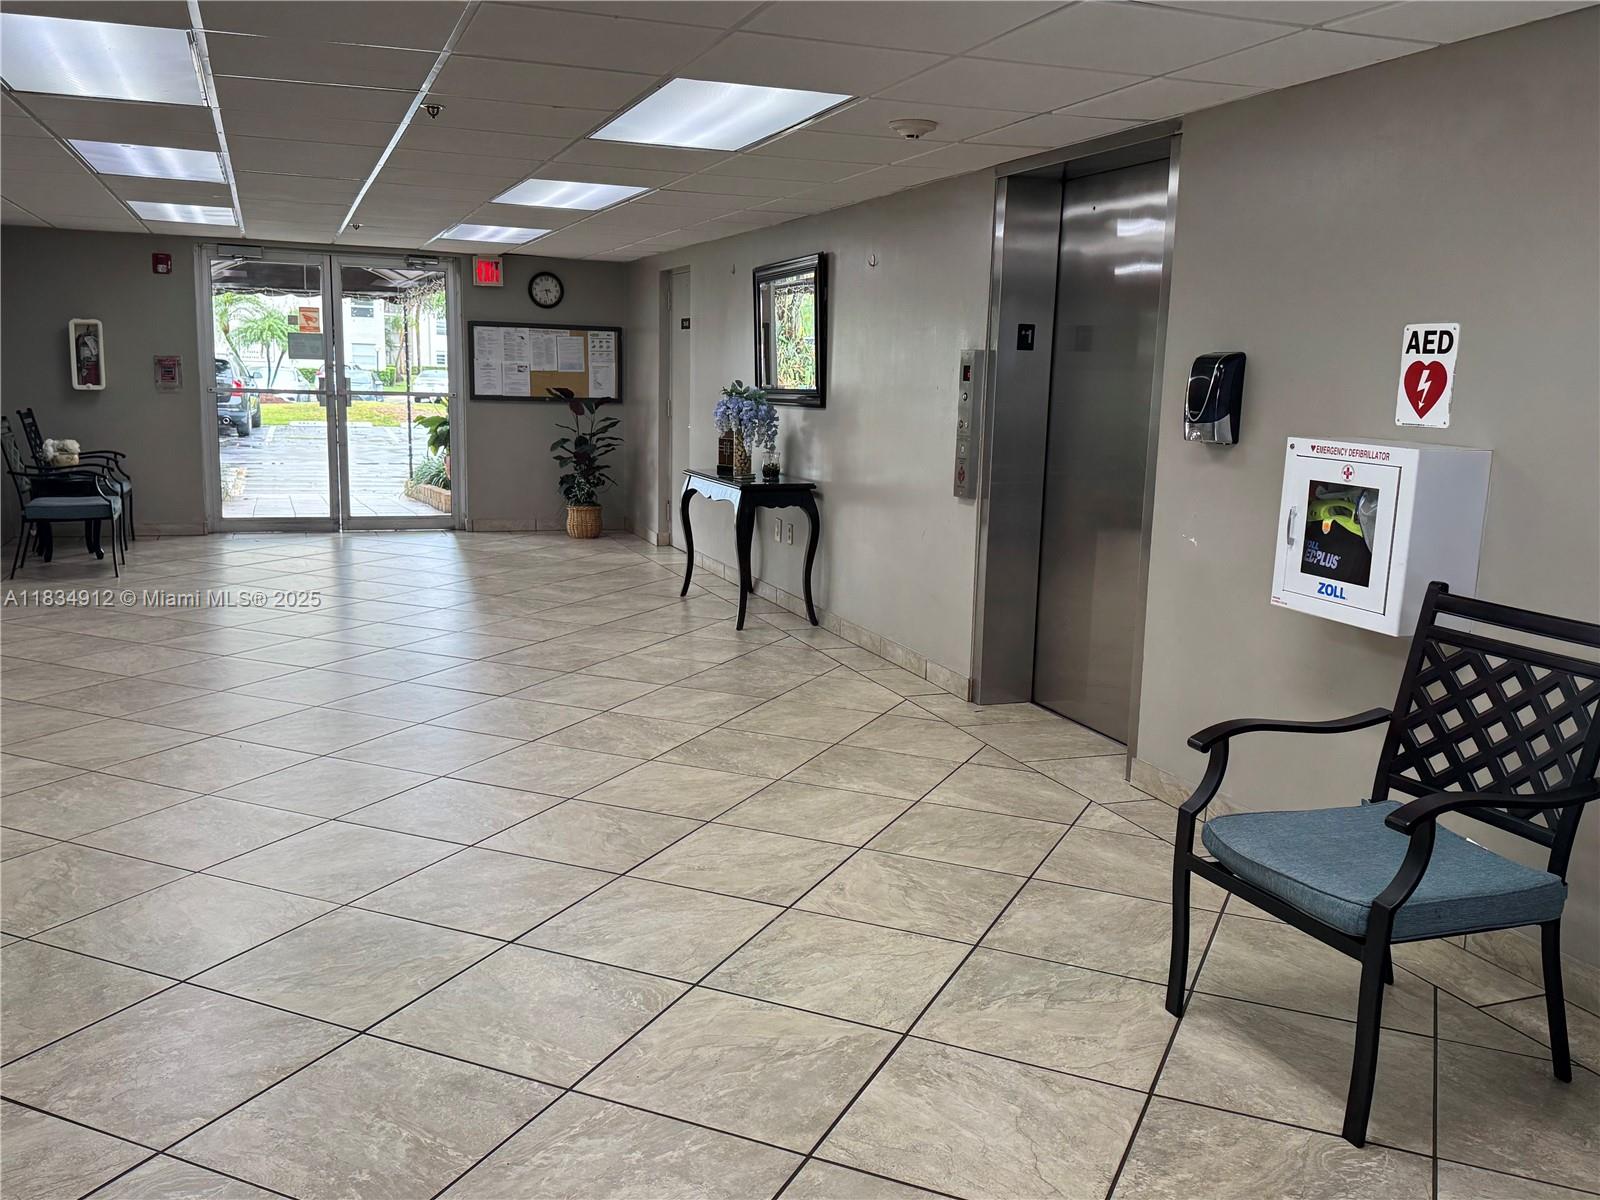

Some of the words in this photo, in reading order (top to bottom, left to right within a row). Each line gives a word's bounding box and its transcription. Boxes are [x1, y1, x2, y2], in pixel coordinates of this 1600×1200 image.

[1405, 330, 1454, 354] AED
[1316, 445, 1348, 456] EMERGENCY
[1348, 448, 1390, 461] DEFIBRILLATOR
[1306, 540, 1319, 550] OLL
[1317, 581, 1346, 600] ZOLL
